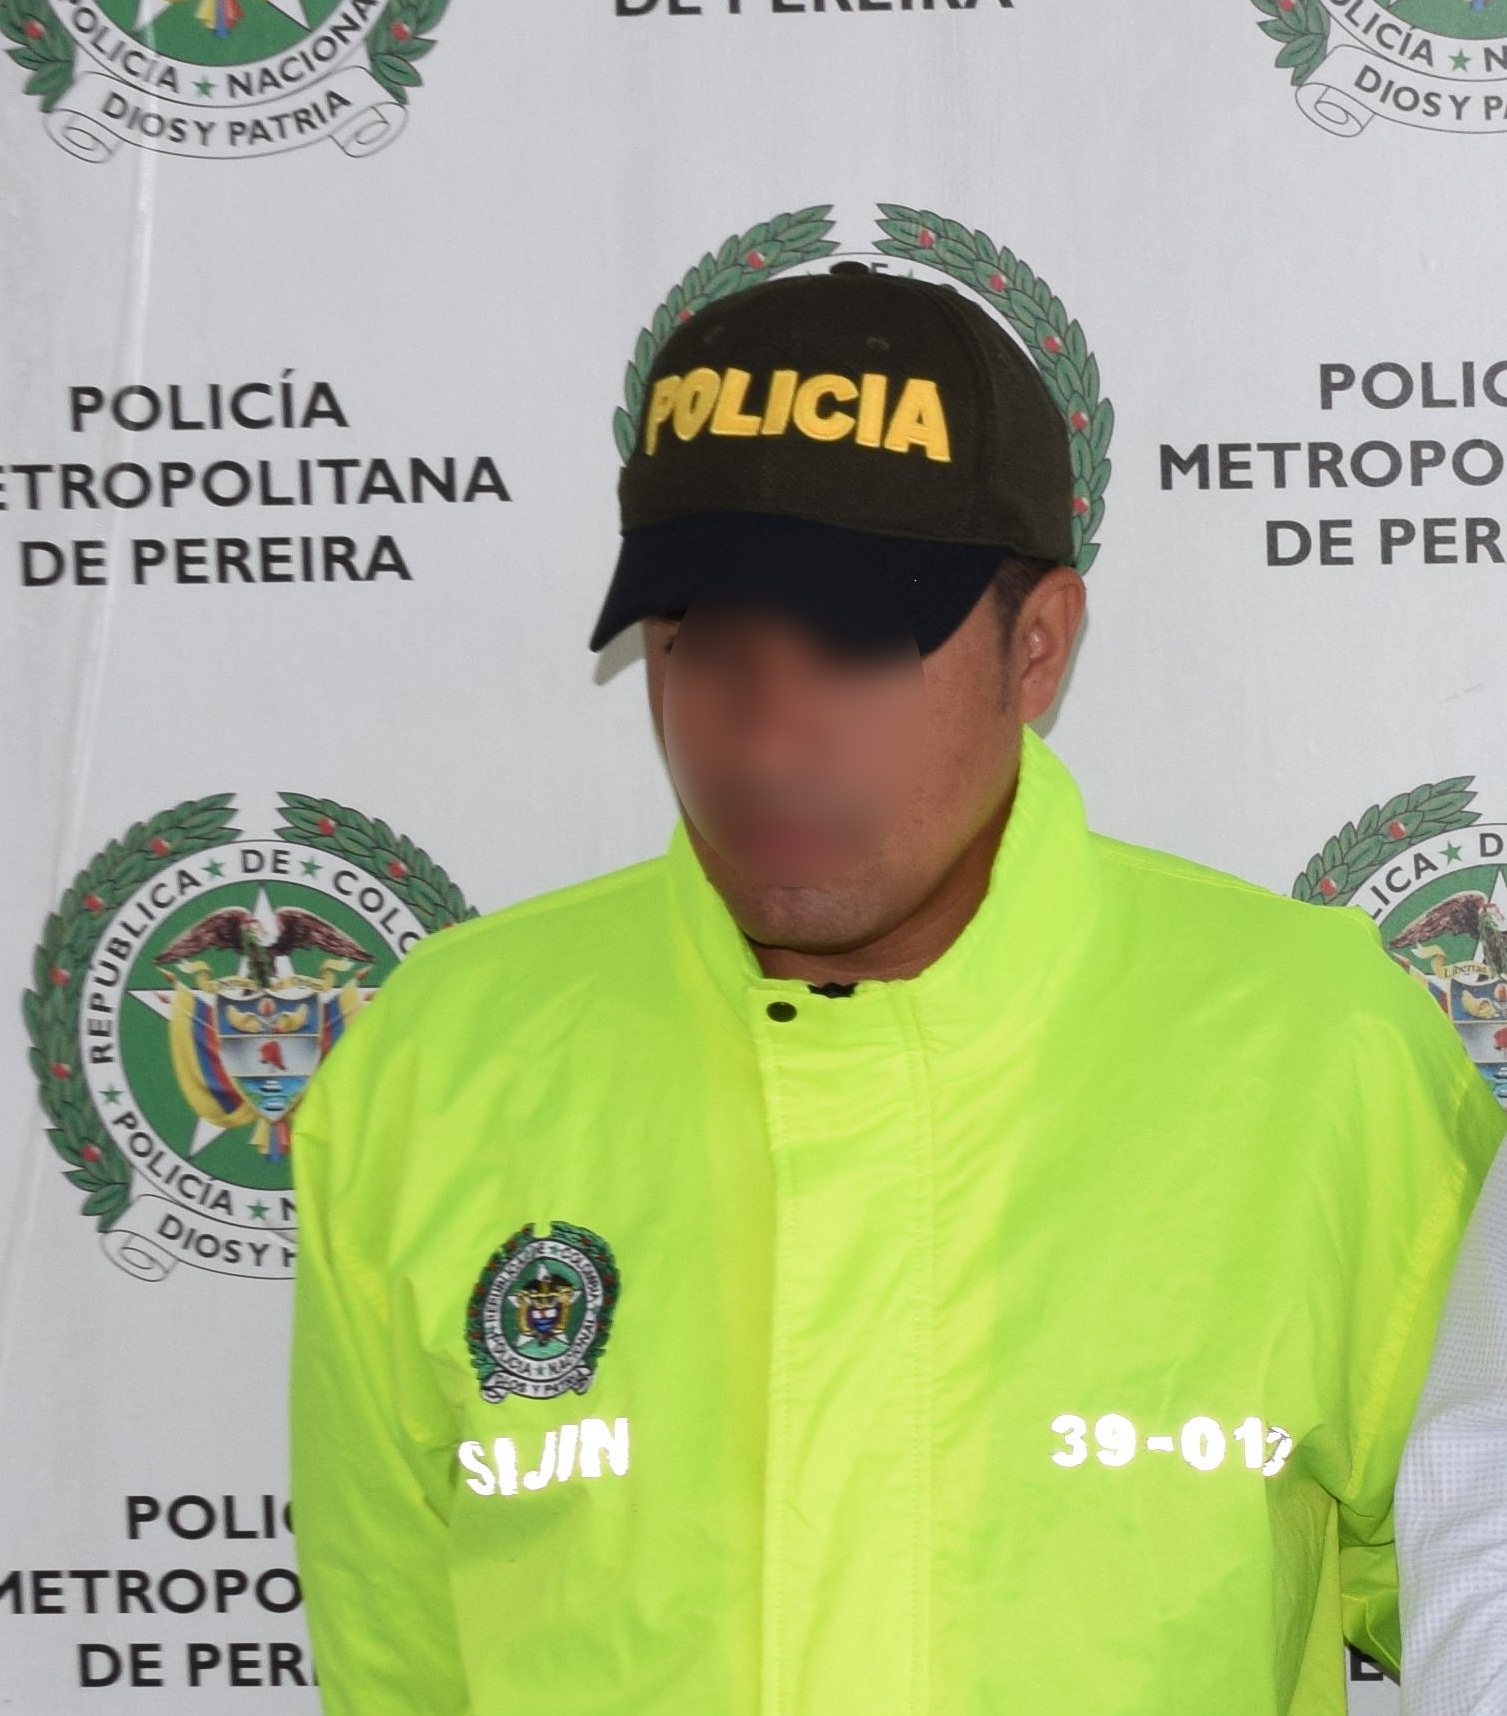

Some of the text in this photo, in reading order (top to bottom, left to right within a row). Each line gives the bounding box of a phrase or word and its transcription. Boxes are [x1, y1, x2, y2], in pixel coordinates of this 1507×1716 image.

[102, 92, 185, 143] DIOS
[228, 90, 353, 146] PATRIA
[1354, 65, 1441, 117] DIOS
[71, 369, 348, 432] POLICÍA
[644, 367, 951, 462] POLICIA
[22, 536, 412, 586] DE PEREIRA
[1265, 520, 1354, 566] DE
[91, 869, 201, 1064] REPÚBLICA
[241, 849, 290, 874] DE
[113, 1112, 234, 1216] POLICÍA
[157, 1214, 243, 1266] DIOS
[458, 1416, 629, 1497] SIJIN
[78, 1644, 163, 1687] DE
